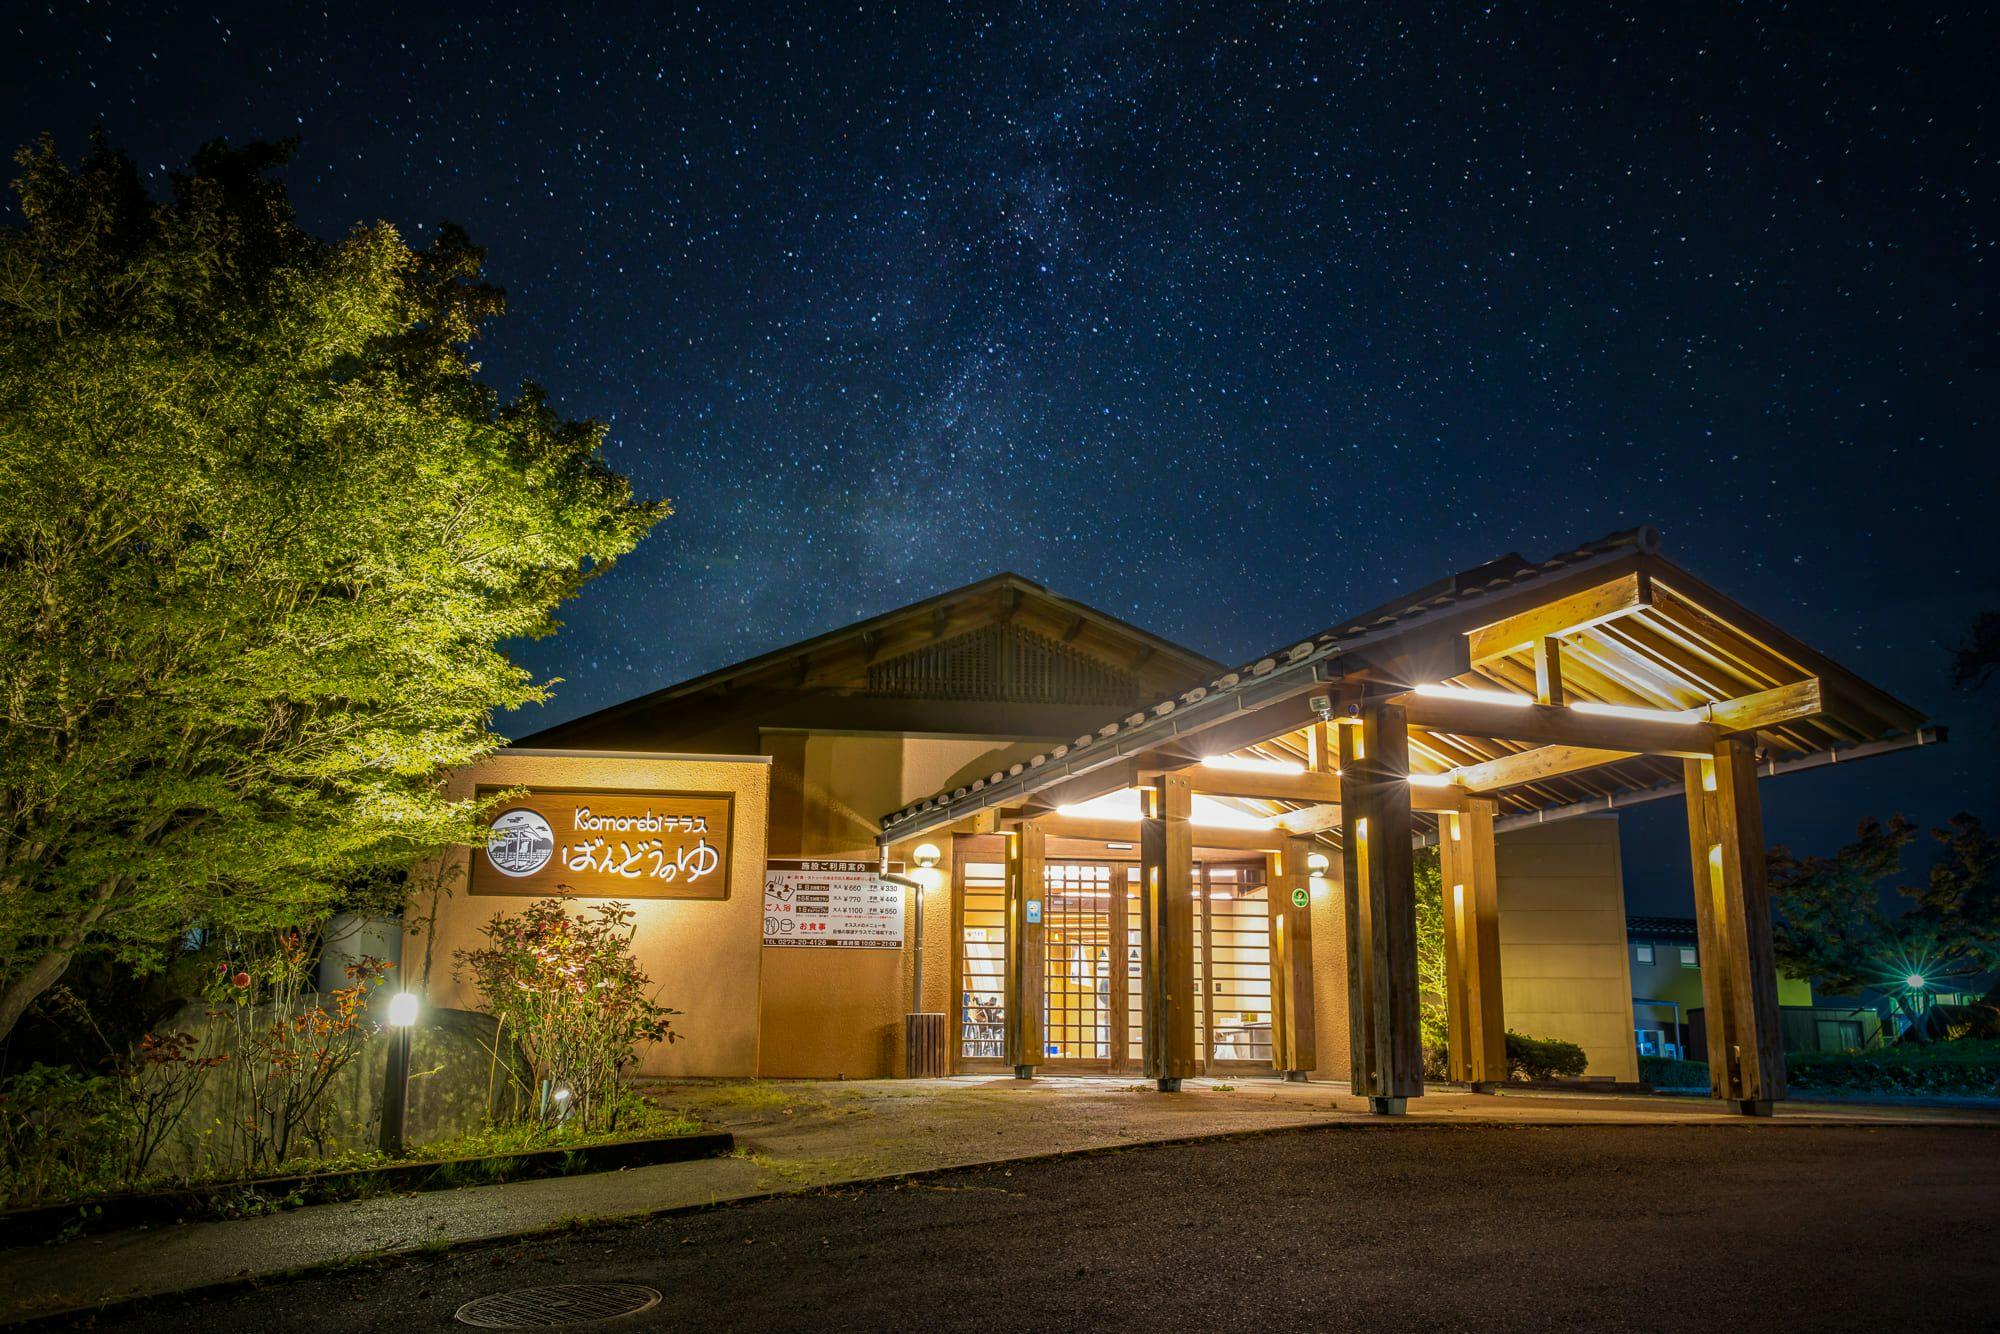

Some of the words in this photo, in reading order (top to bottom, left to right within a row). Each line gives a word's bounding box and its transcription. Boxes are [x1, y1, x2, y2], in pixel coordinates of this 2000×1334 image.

[562, 838, 719, 883] ばんどうのゆ
[802, 863, 865, 871] 施設ご利用案内
[765, 904, 792, 912] ご入浴
